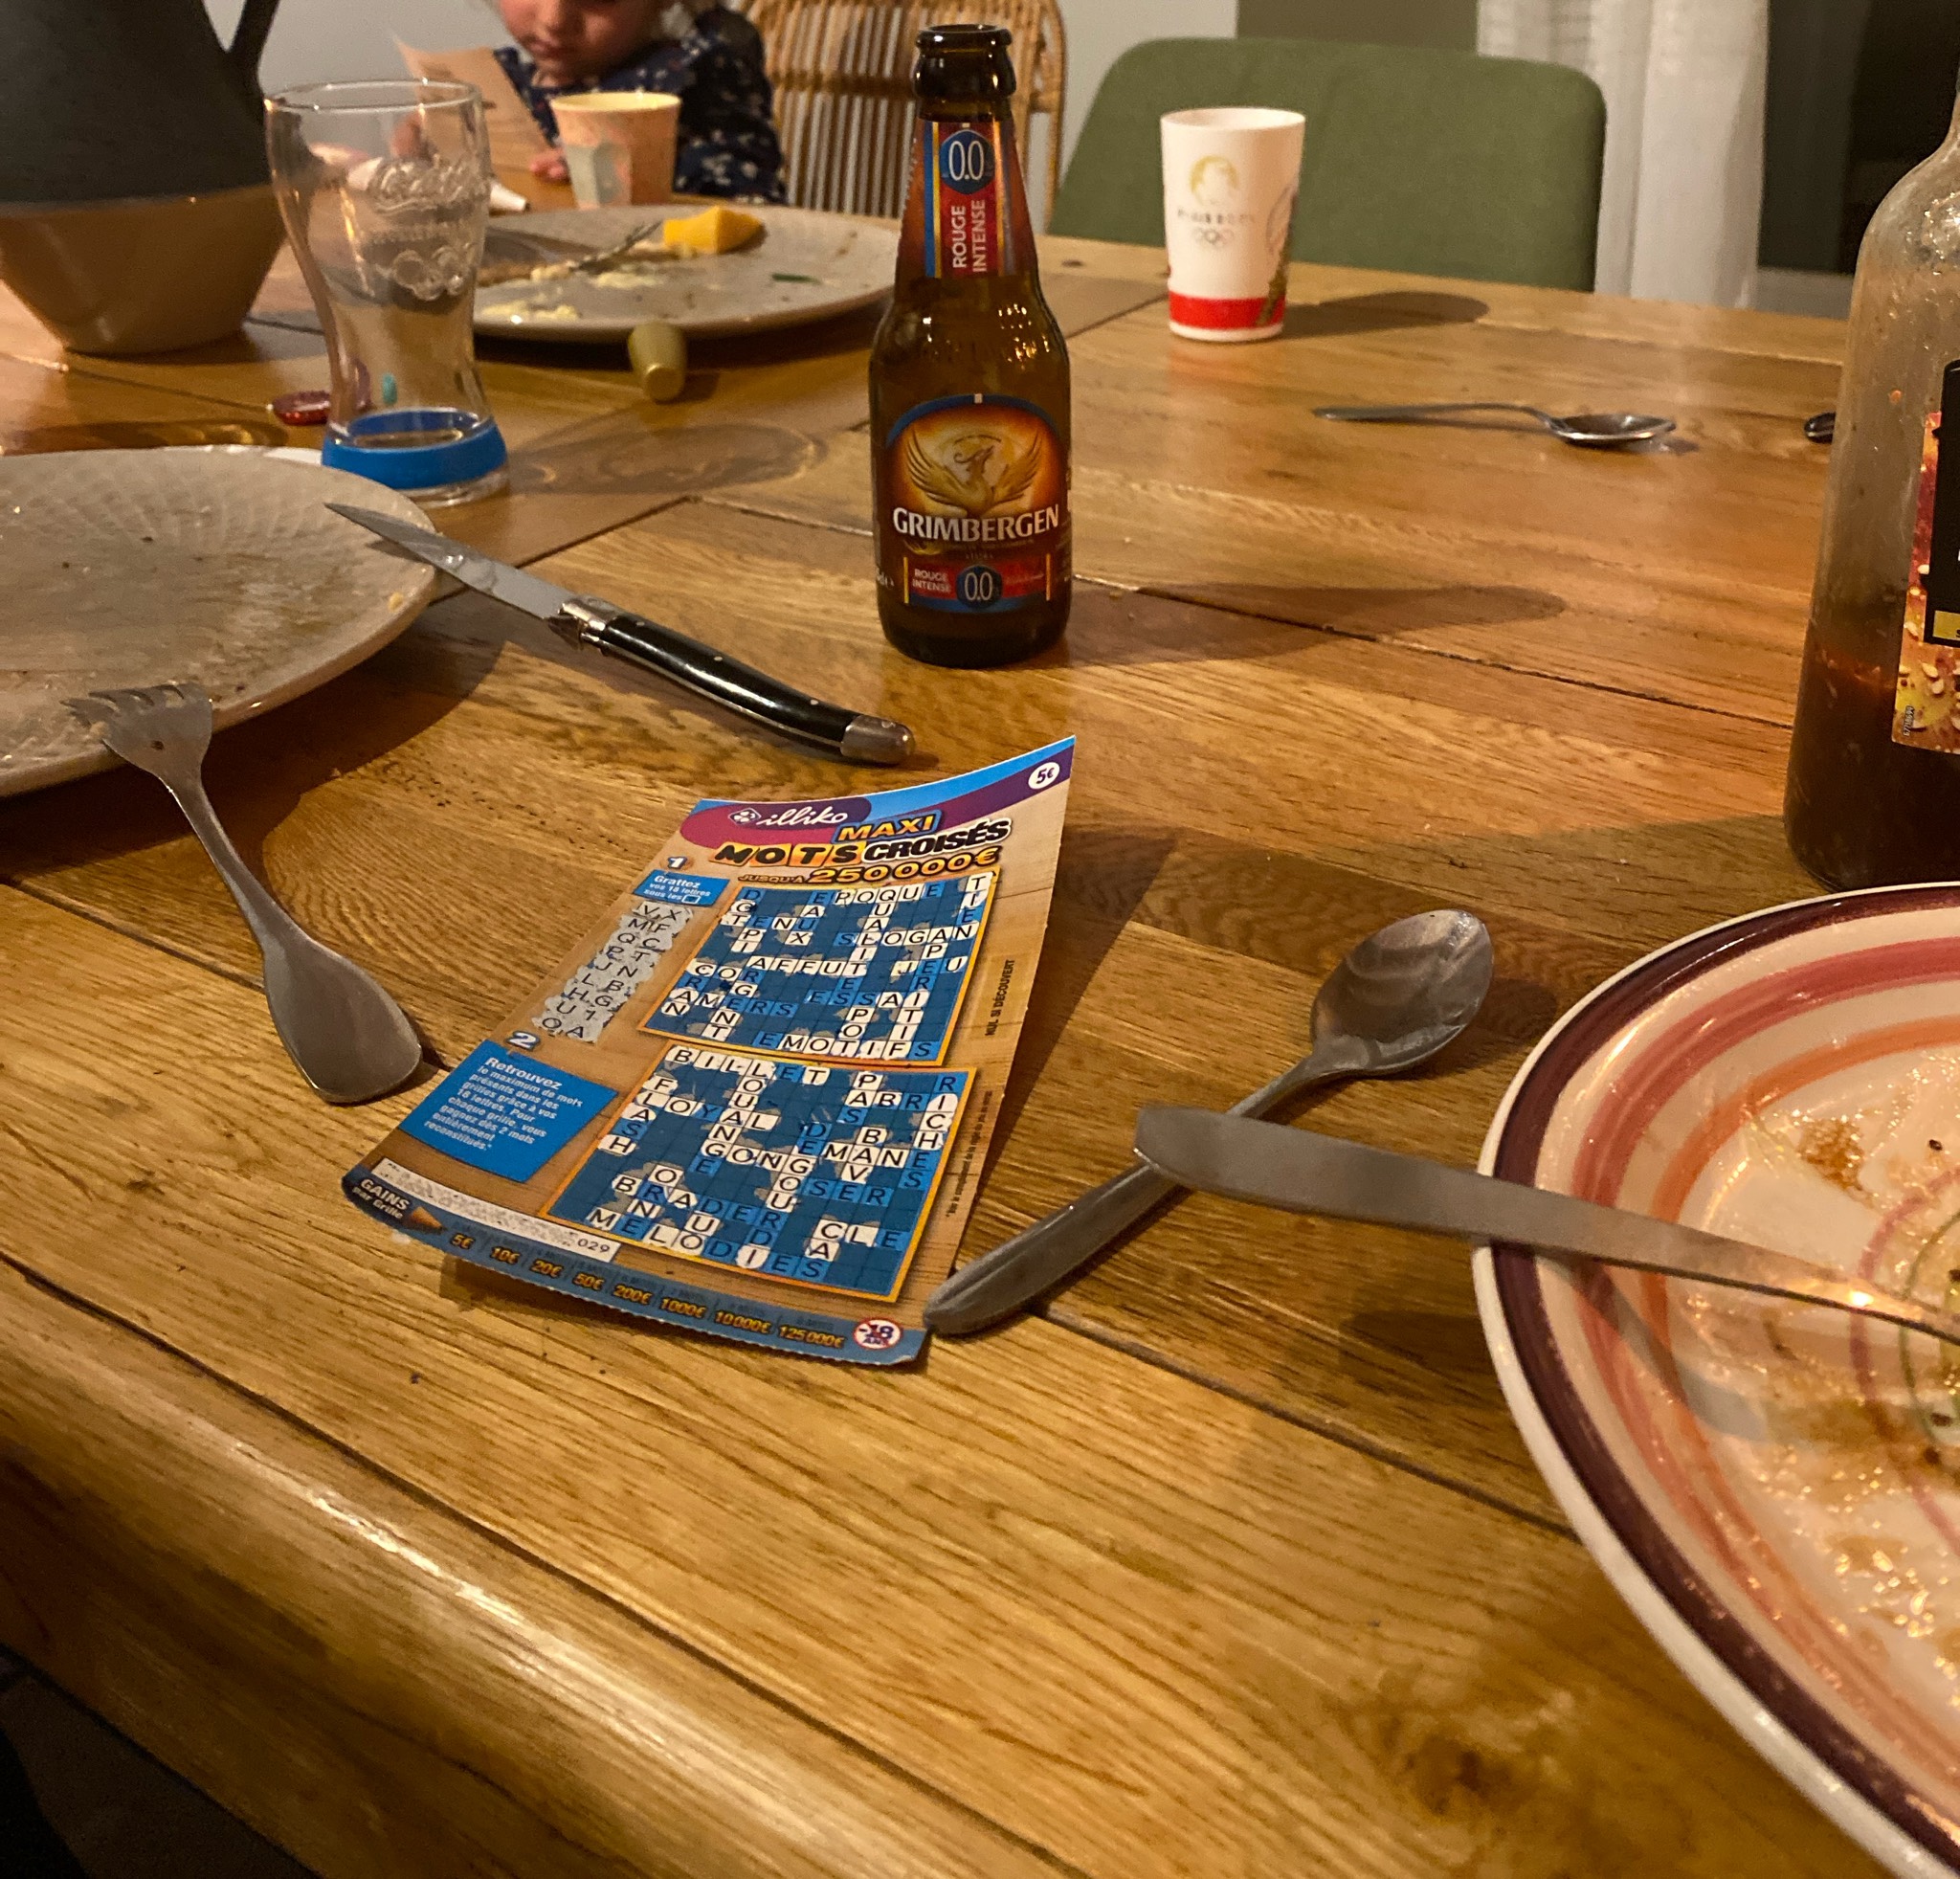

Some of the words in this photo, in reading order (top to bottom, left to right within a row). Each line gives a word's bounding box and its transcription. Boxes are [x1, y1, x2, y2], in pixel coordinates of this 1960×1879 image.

[948, 140, 985, 181] 0.0
[951, 205, 967, 268] ROUGE
[971, 200, 987, 272] INTENSE
[893, 503, 1059, 542] GRIMBERGEN
[912, 578, 951, 593] INTENSE
[914, 568, 948, 580] ROUGE
[965, 572, 993, 601] 0.0
[1036, 768, 1057, 784] 5€
[761, 806, 849, 828] illiko
[838, 816, 934, 840] MAXI
[715, 844, 859, 864] MOTS
[863, 820, 1009, 861] CROISÉS
[669, 857, 686, 869] 1
[655, 875, 701, 888] Grattez
[508, 1030, 539, 1050] 2
[485, 1057, 563, 1091] Retrouvez
[490, 1070, 540, 1094] maximum
[542, 1088, 555, 1098] de
[557, 1093, 584, 1107] mots
[516, 1089, 542, 1105] dans
[509, 1108, 535, 1123] Pour
[538, 1108, 558, 1120] vos
[521, 1124, 547, 1138] vous
[360, 1178, 410, 1211] GAINS
[451, 1232, 475, 1249] 5€
[532, 1260, 563, 1278] 20€
[574, 1272, 605, 1290] 50€
[613, 1285, 653, 1305] 200€
